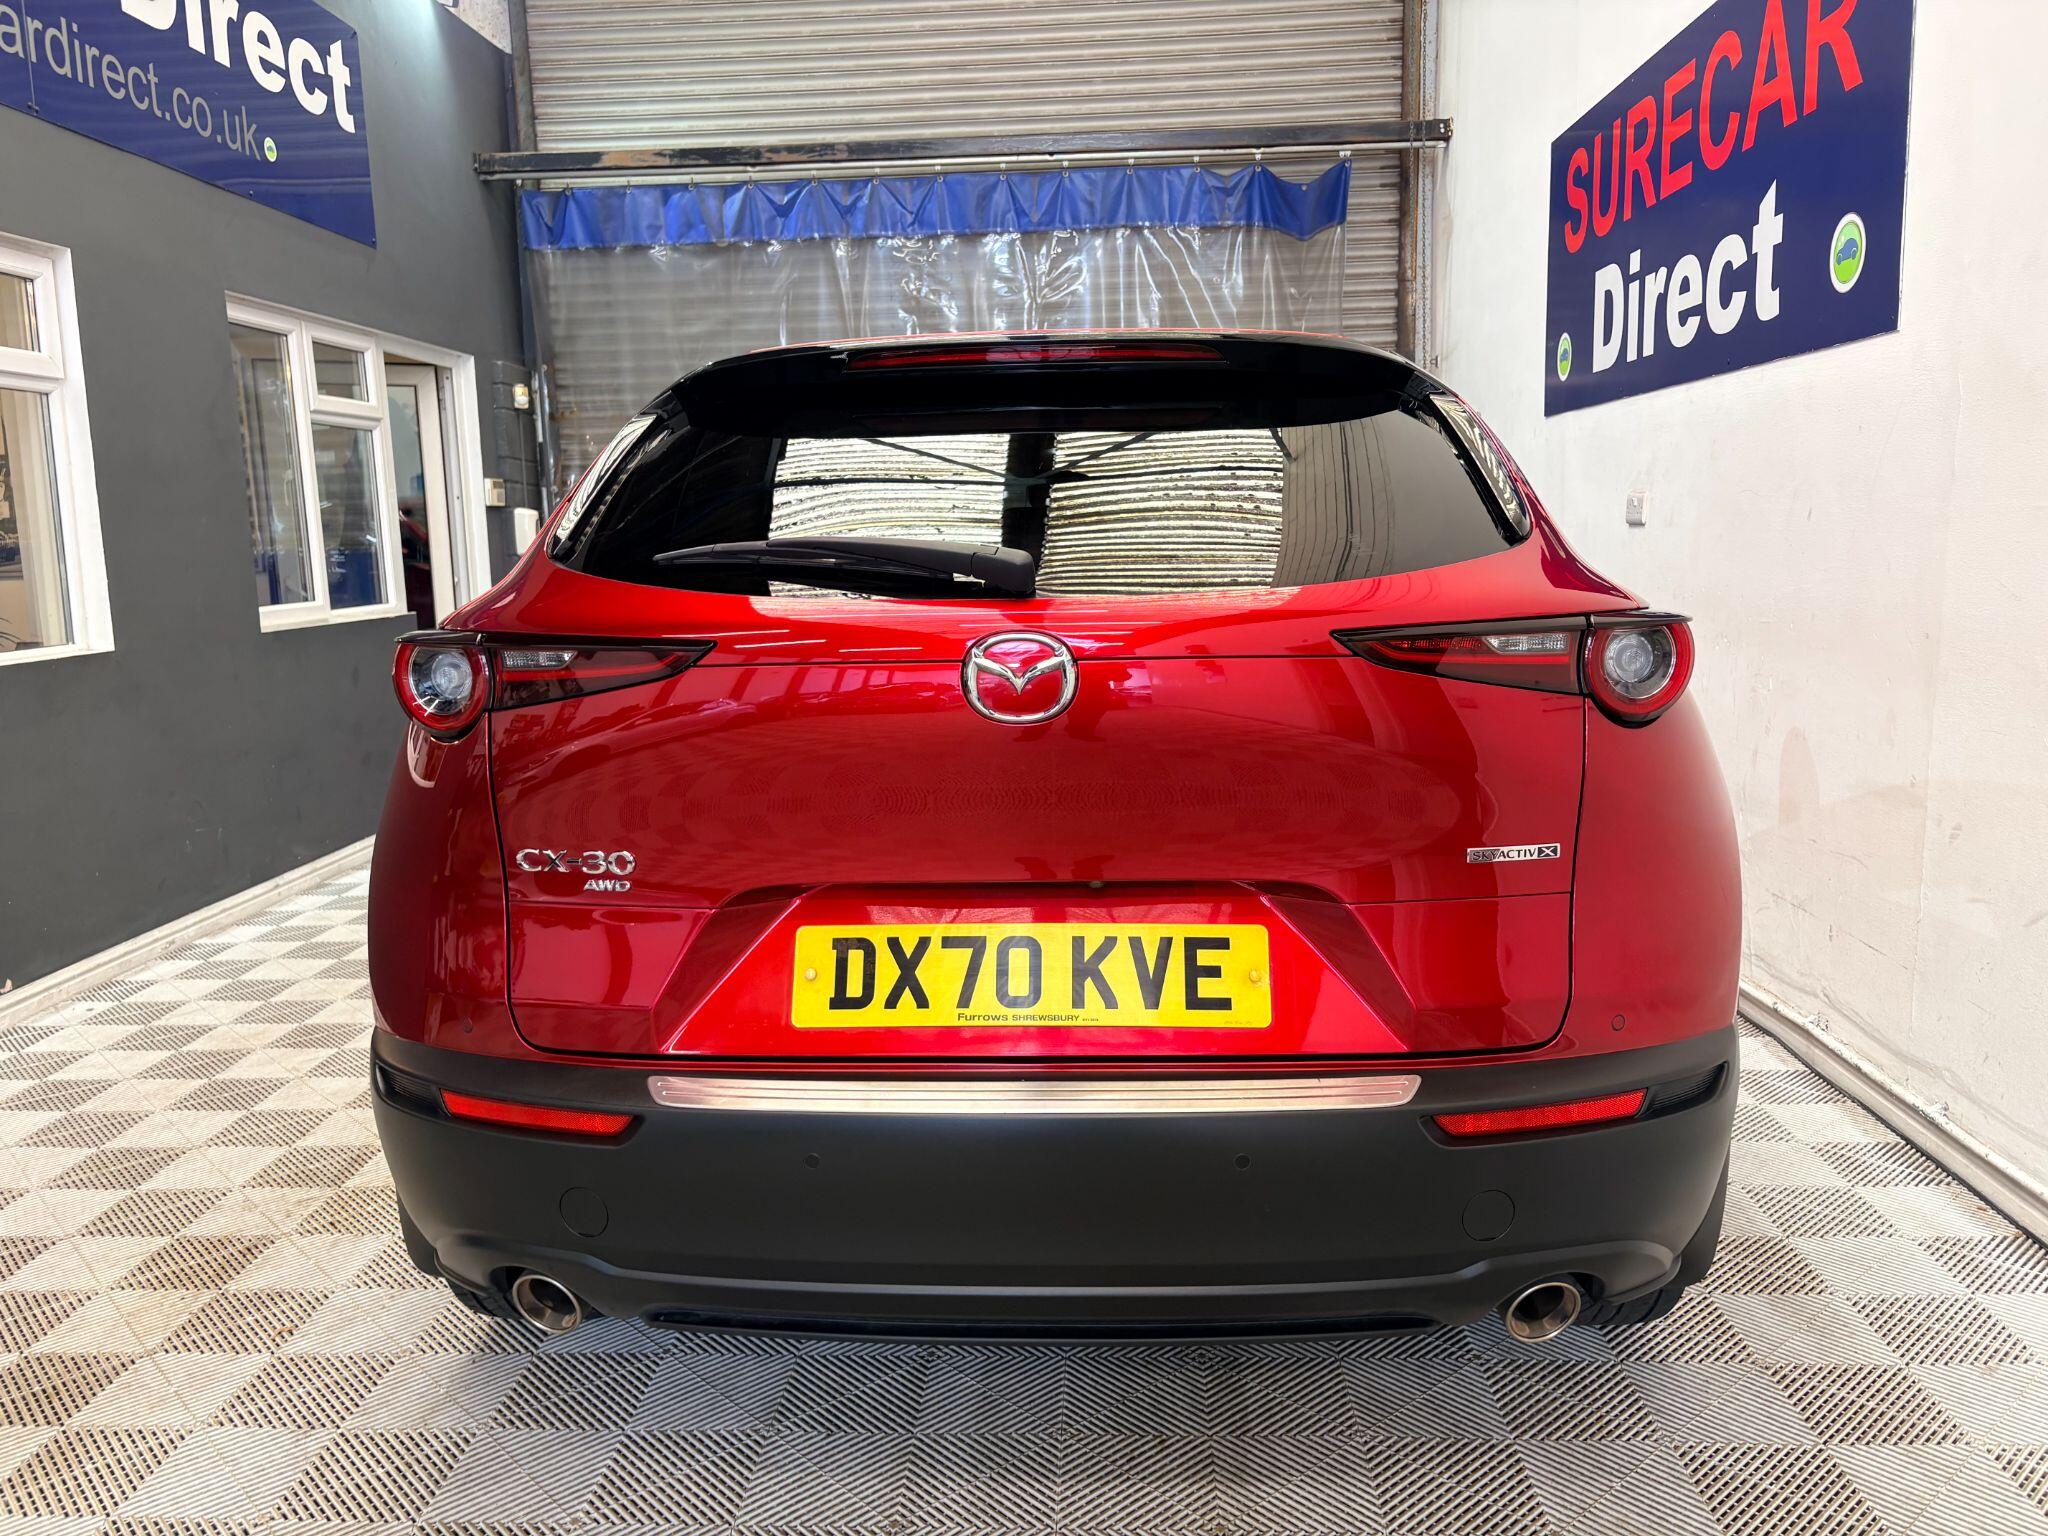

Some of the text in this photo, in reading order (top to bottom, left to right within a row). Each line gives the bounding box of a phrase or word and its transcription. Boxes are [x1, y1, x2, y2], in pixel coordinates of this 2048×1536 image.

[121, 0, 356, 134] rect
[1564, 0, 1863, 254] SURECAR
[1592, 179, 1784, 374] Direct
[515, 848, 636, 876] CX-30
[583, 879, 631, 892] AWD
[829, 935, 1233, 1011] DX70 KVE
[957, 1012, 1009, 1022] Furrows
[1012, 1014, 1080, 1022] SHREWSBURY
